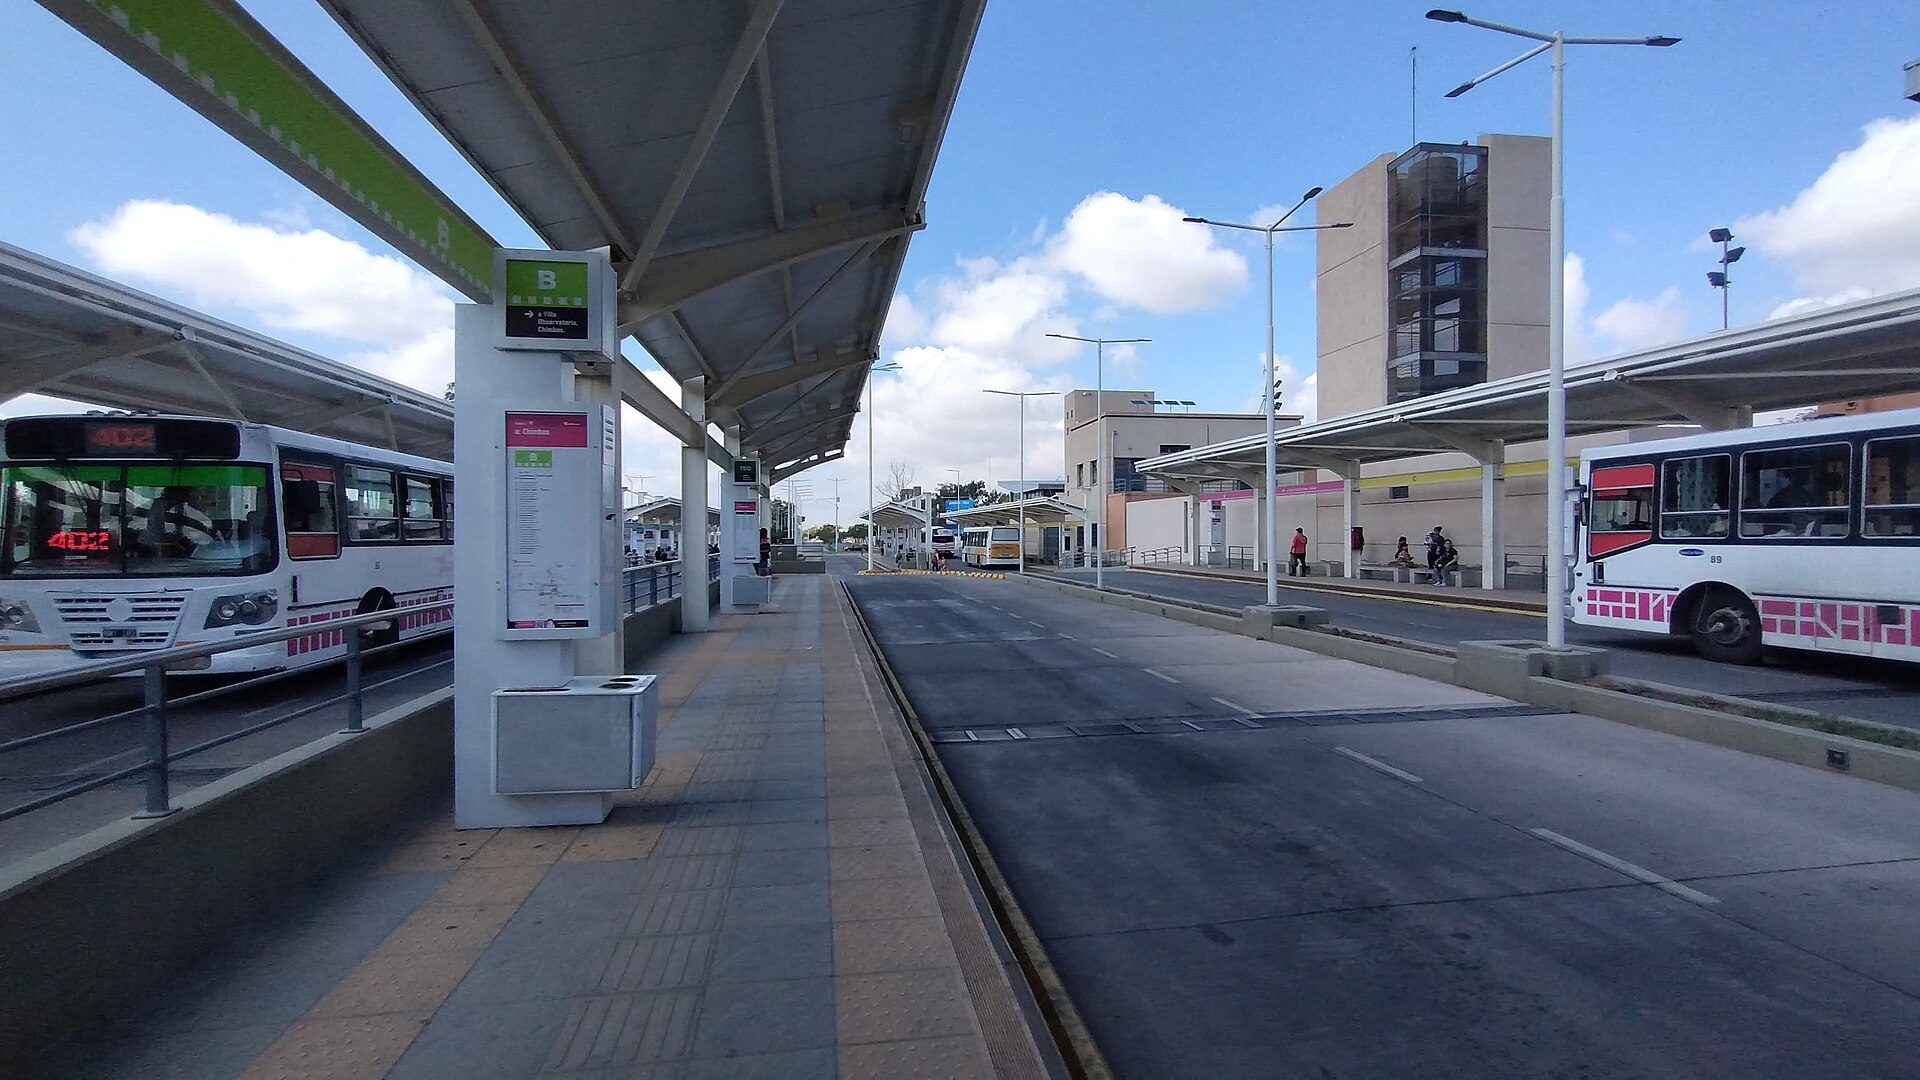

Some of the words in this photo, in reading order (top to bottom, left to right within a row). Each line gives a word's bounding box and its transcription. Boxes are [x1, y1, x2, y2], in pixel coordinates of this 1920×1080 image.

[538, 270, 557, 290] B
[48, 531, 109, 550] 402
[1710, 555, 1723, 564] 89
